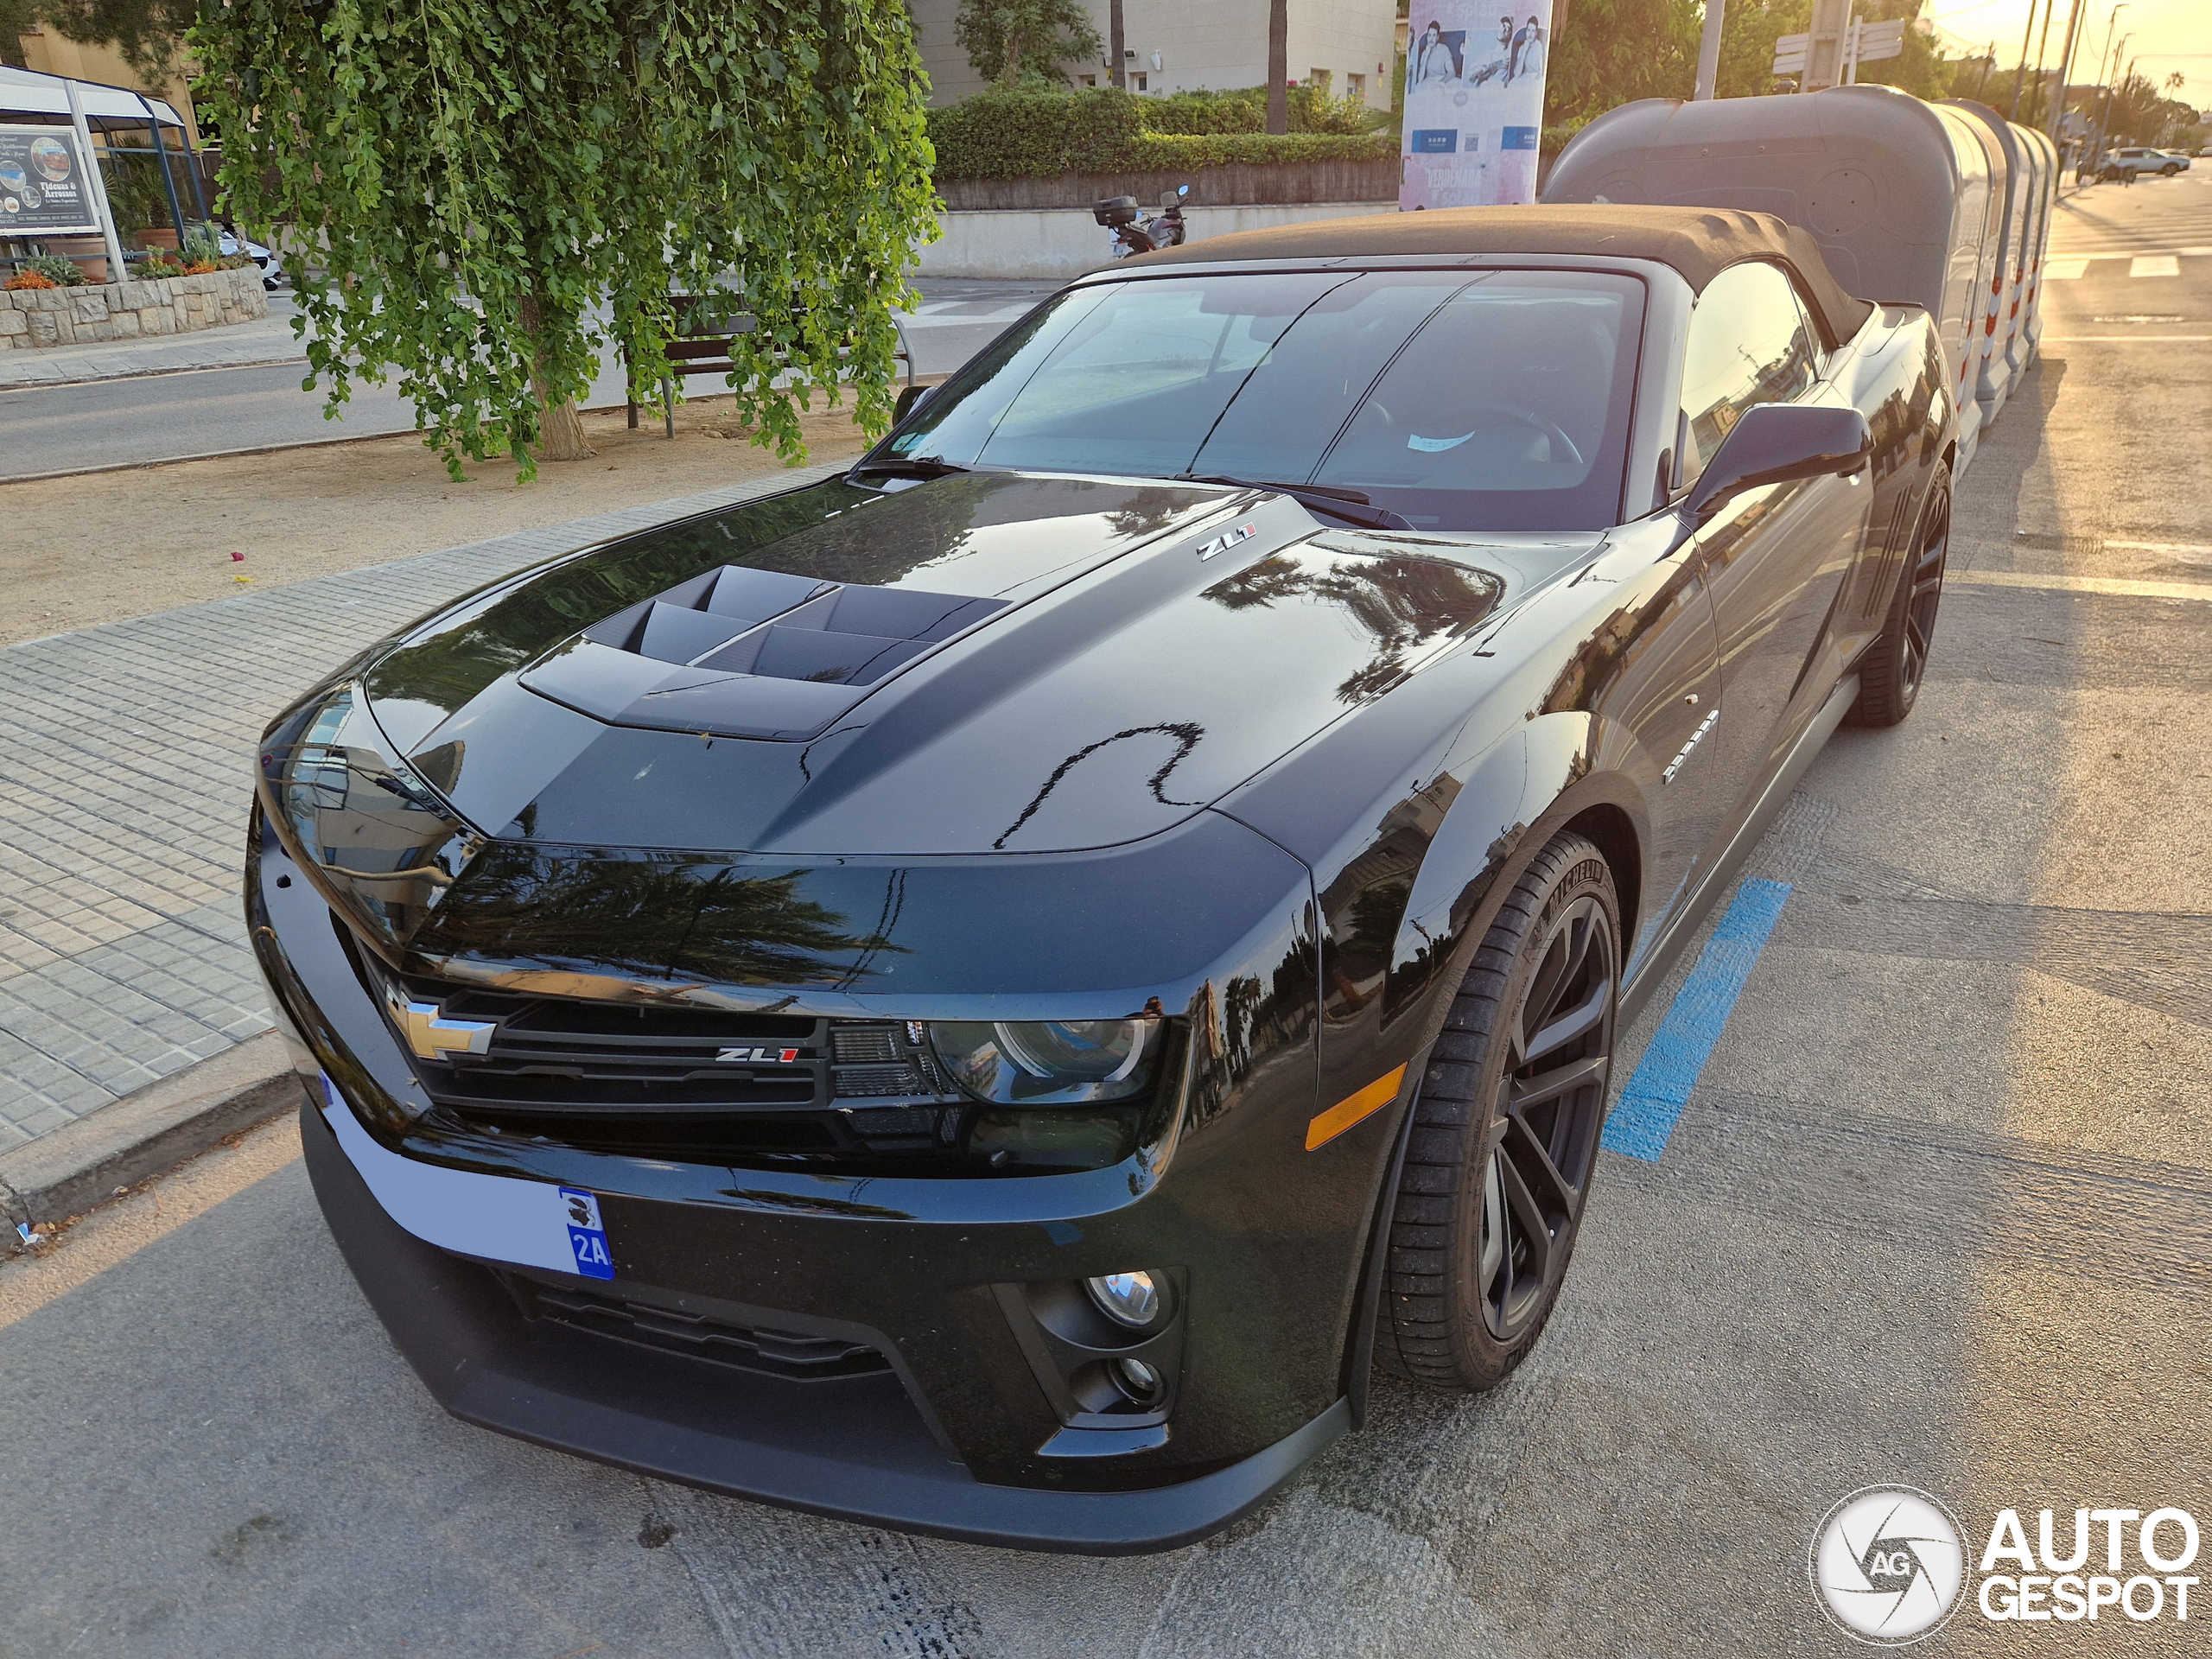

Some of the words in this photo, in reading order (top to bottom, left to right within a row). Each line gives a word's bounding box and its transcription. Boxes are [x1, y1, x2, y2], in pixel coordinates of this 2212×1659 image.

[70, 181, 76, 190] &
[1197, 522, 1256, 563] ZL1
[1548, 859, 1604, 919] MICHELIN
[715, 1046, 799, 1063] ZL1
[573, 1234, 609, 1266] 2A
